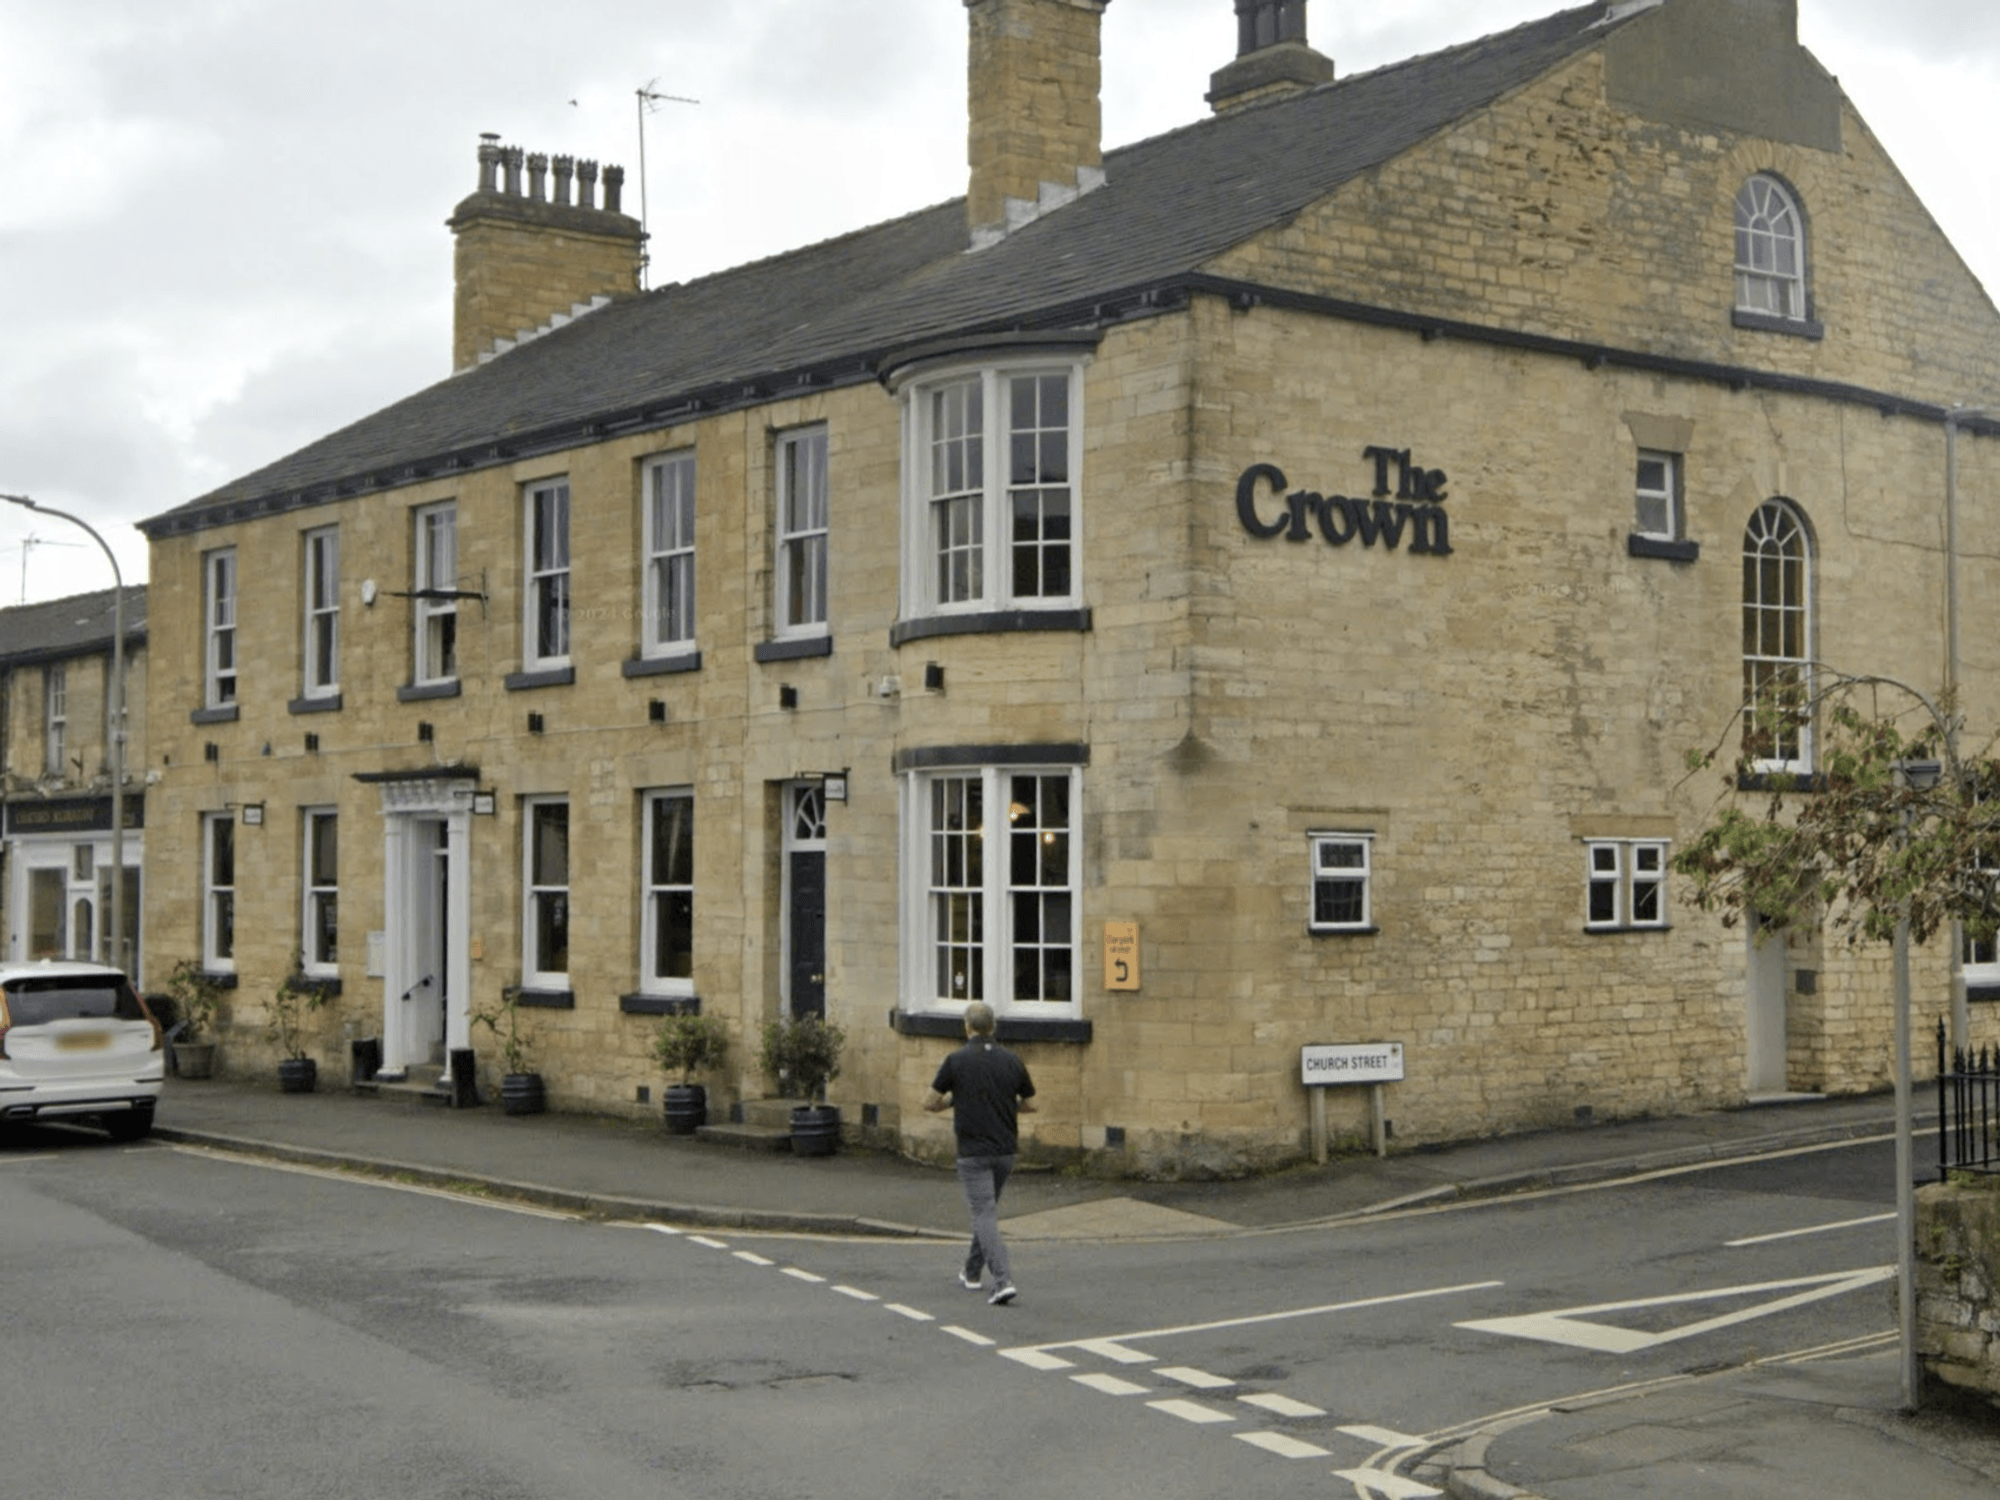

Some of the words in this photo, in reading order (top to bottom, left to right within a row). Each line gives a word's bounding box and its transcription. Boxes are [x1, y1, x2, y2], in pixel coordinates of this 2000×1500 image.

[1362, 445, 1448, 503] The
[1236, 463, 1453, 555] Crown
[1307, 1057, 1348, 1071] CHURCH
[1351, 1055, 1388, 1070] STREET
